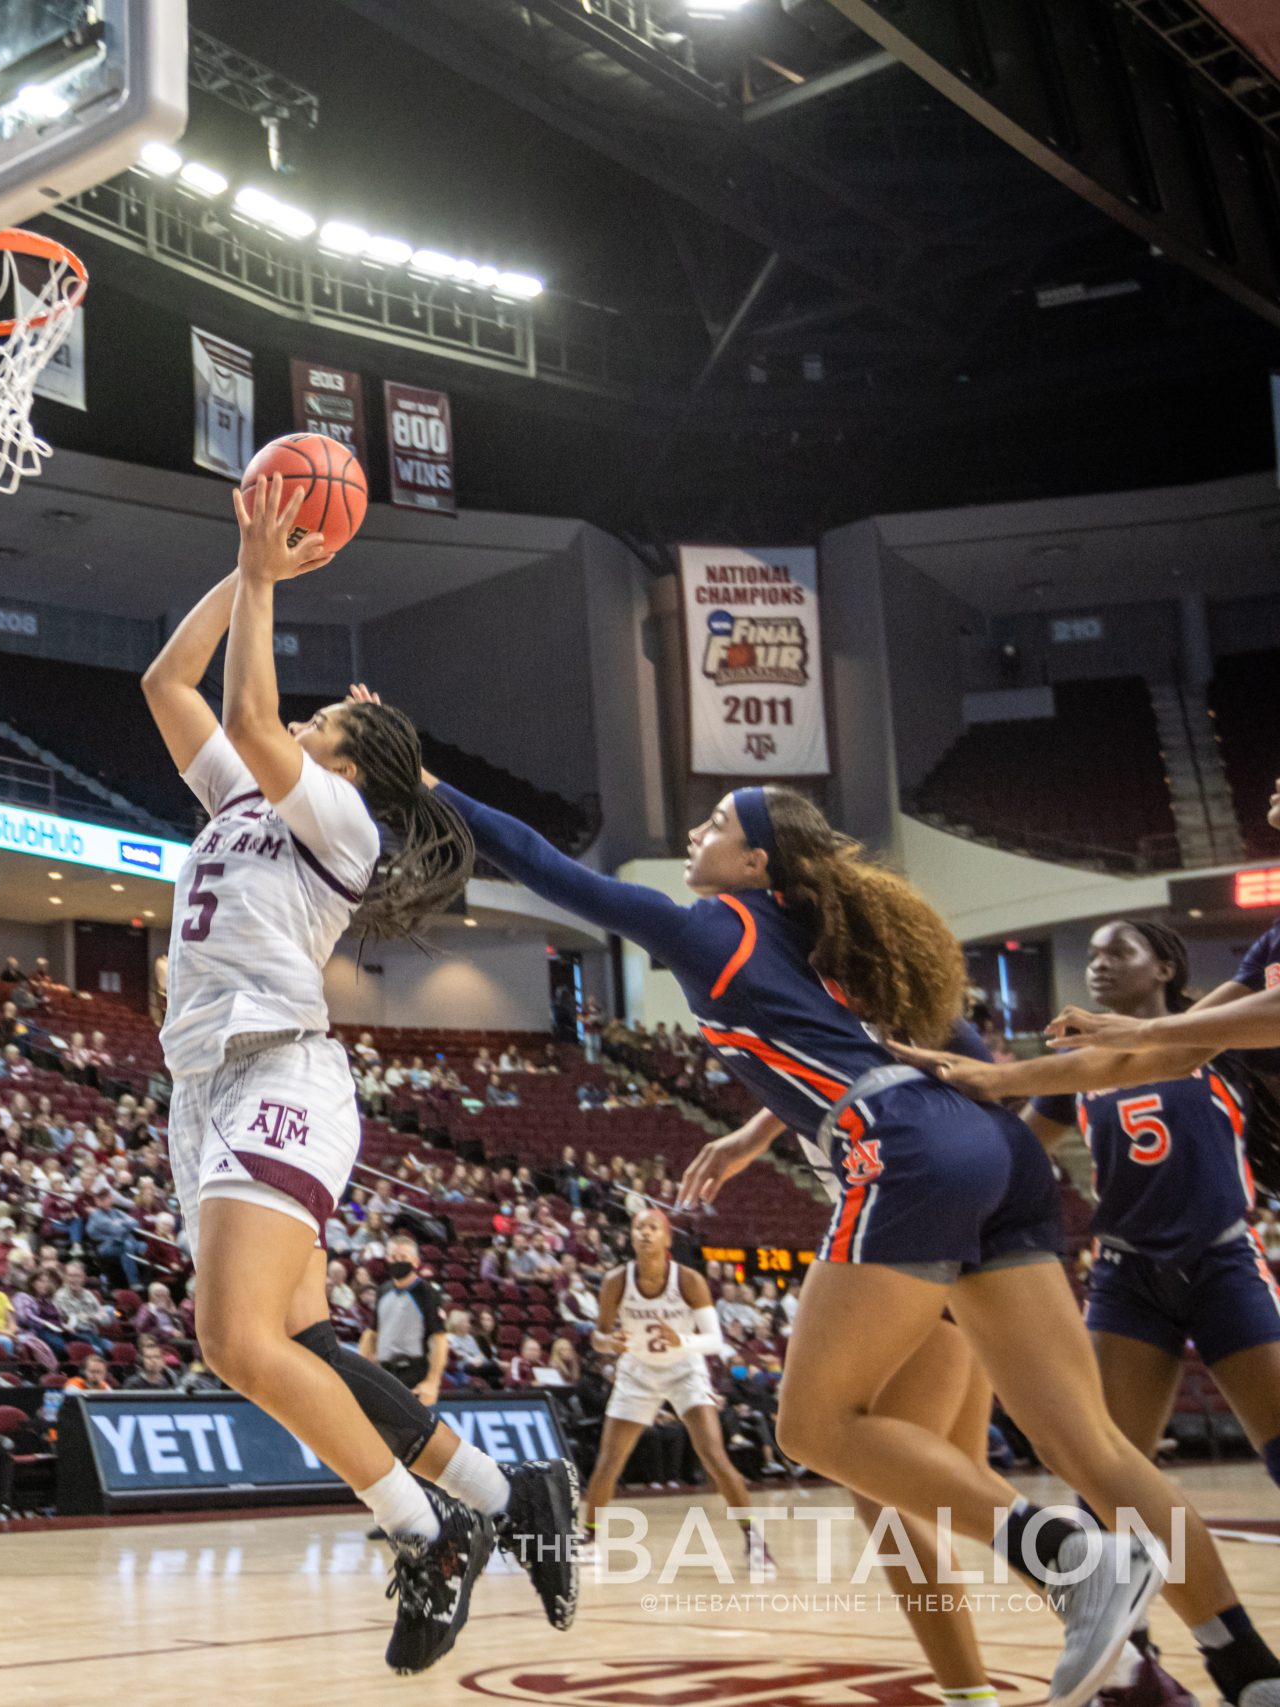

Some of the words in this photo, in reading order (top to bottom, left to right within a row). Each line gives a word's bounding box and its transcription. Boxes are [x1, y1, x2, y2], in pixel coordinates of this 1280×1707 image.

[392, 410, 448, 454] 800
[395, 456, 452, 489] WINS
[695, 586, 805, 605] CHAMPIONS
[705, 565, 791, 584] NATIONAL
[723, 695, 794, 726] 2011
[181, 862, 226, 943] 5
[1118, 1093, 1172, 1166] 5
[90, 1413, 243, 1475] YETI
[439, 1409, 563, 1465] YETI
